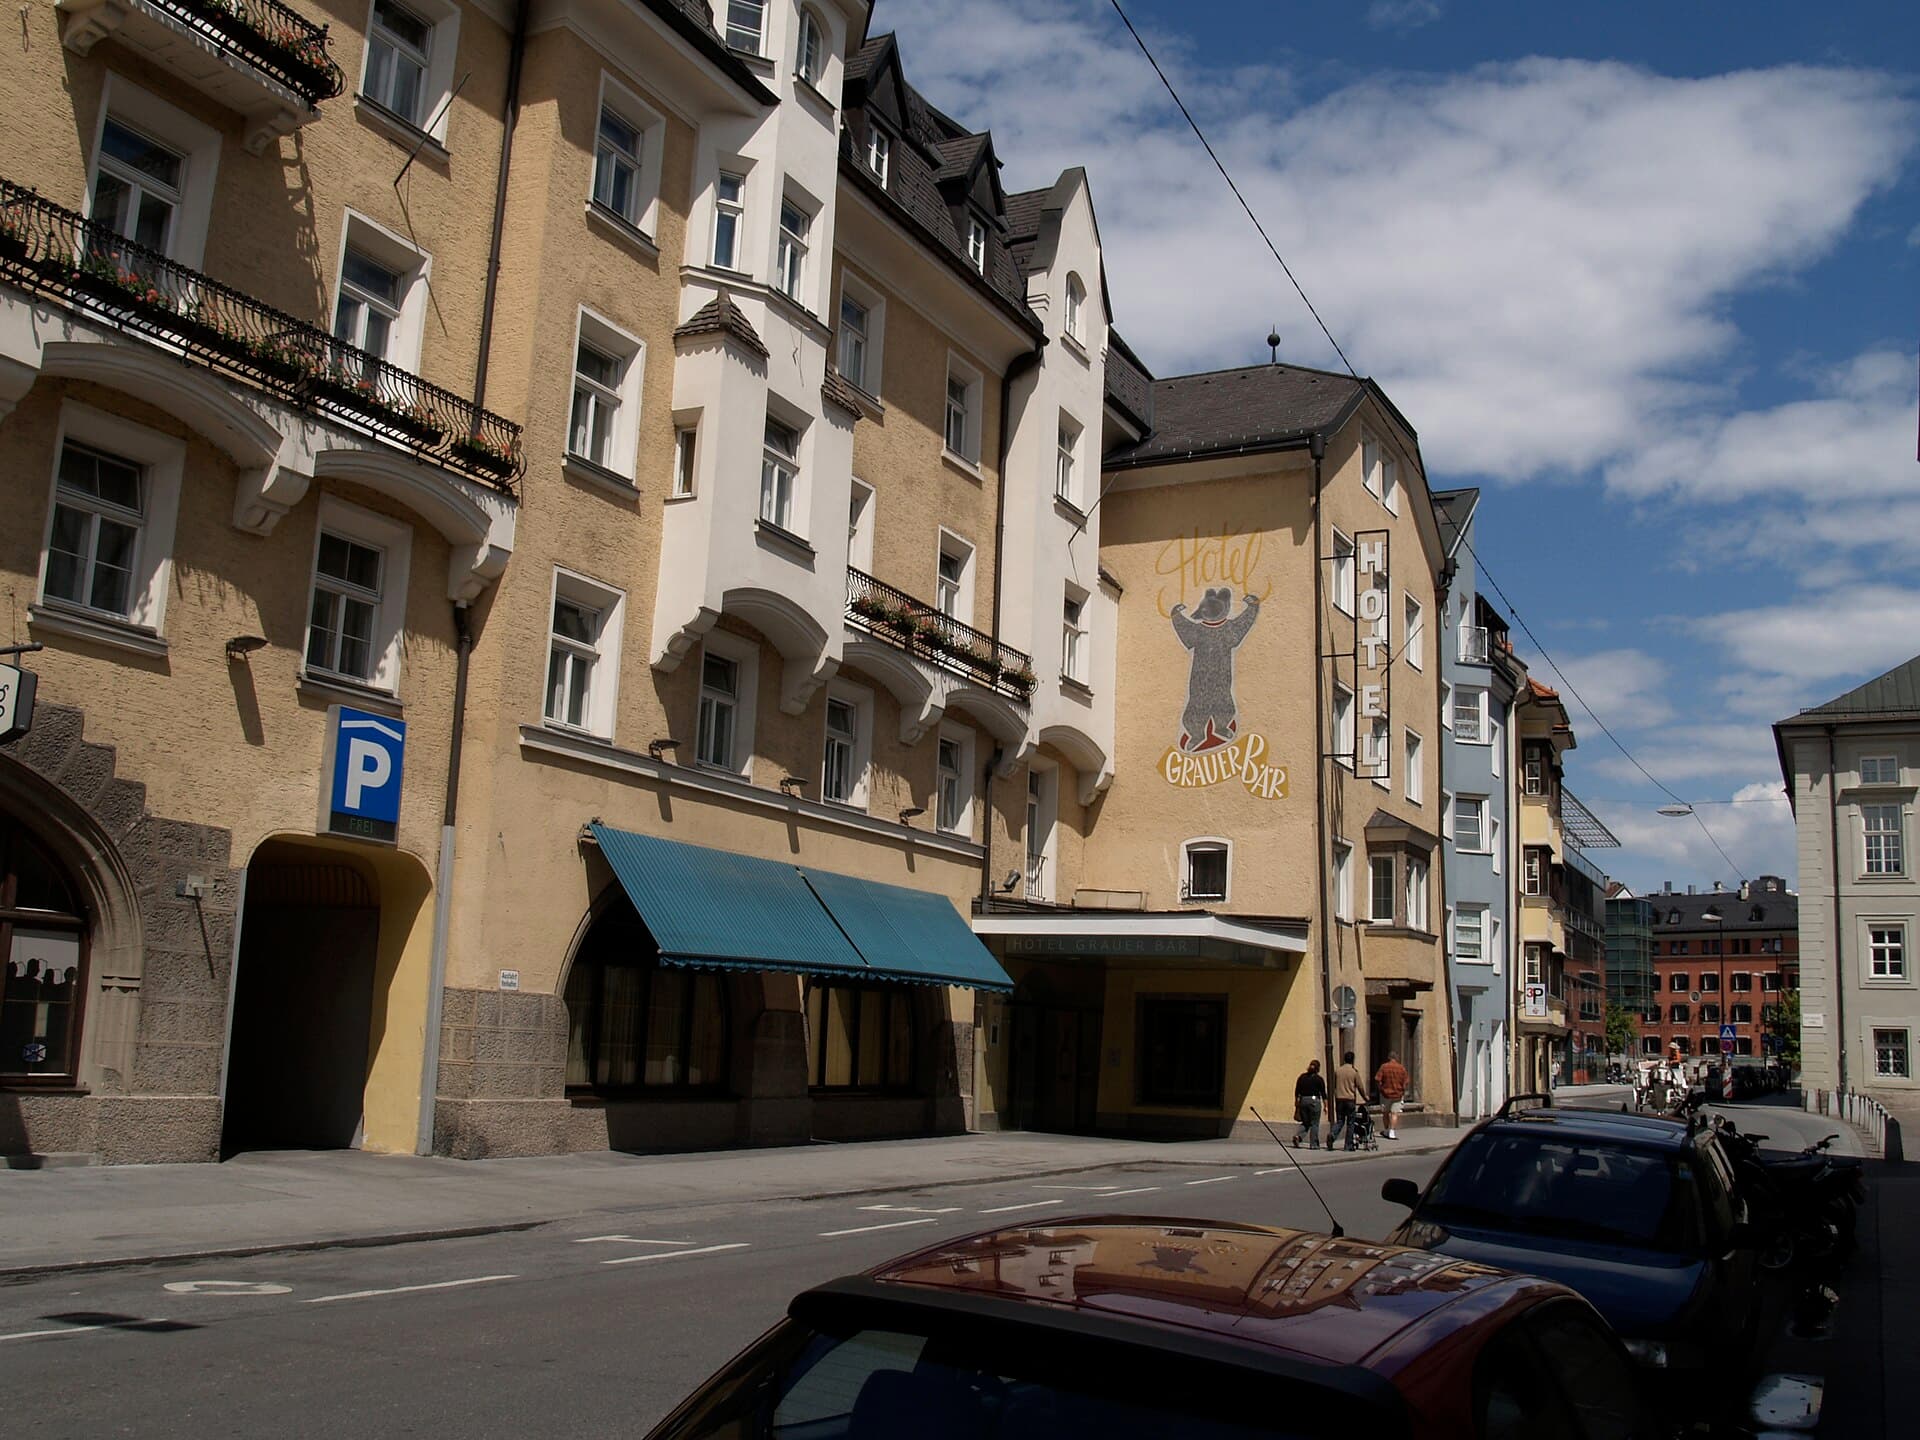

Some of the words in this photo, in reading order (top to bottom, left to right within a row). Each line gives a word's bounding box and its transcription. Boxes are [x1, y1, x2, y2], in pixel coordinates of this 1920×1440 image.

[1155, 523, 1263, 601] Hotel
[1360, 541, 1384, 766] HOTEL
[344, 737, 392, 810] P
[1165, 744, 1242, 788] GRAUER
[1241, 733, 1287, 799] BÄR
[350, 817, 374, 834] FREI
[1013, 938, 1066, 951] HOTEL
[1074, 938, 1146, 952] GRAUER
